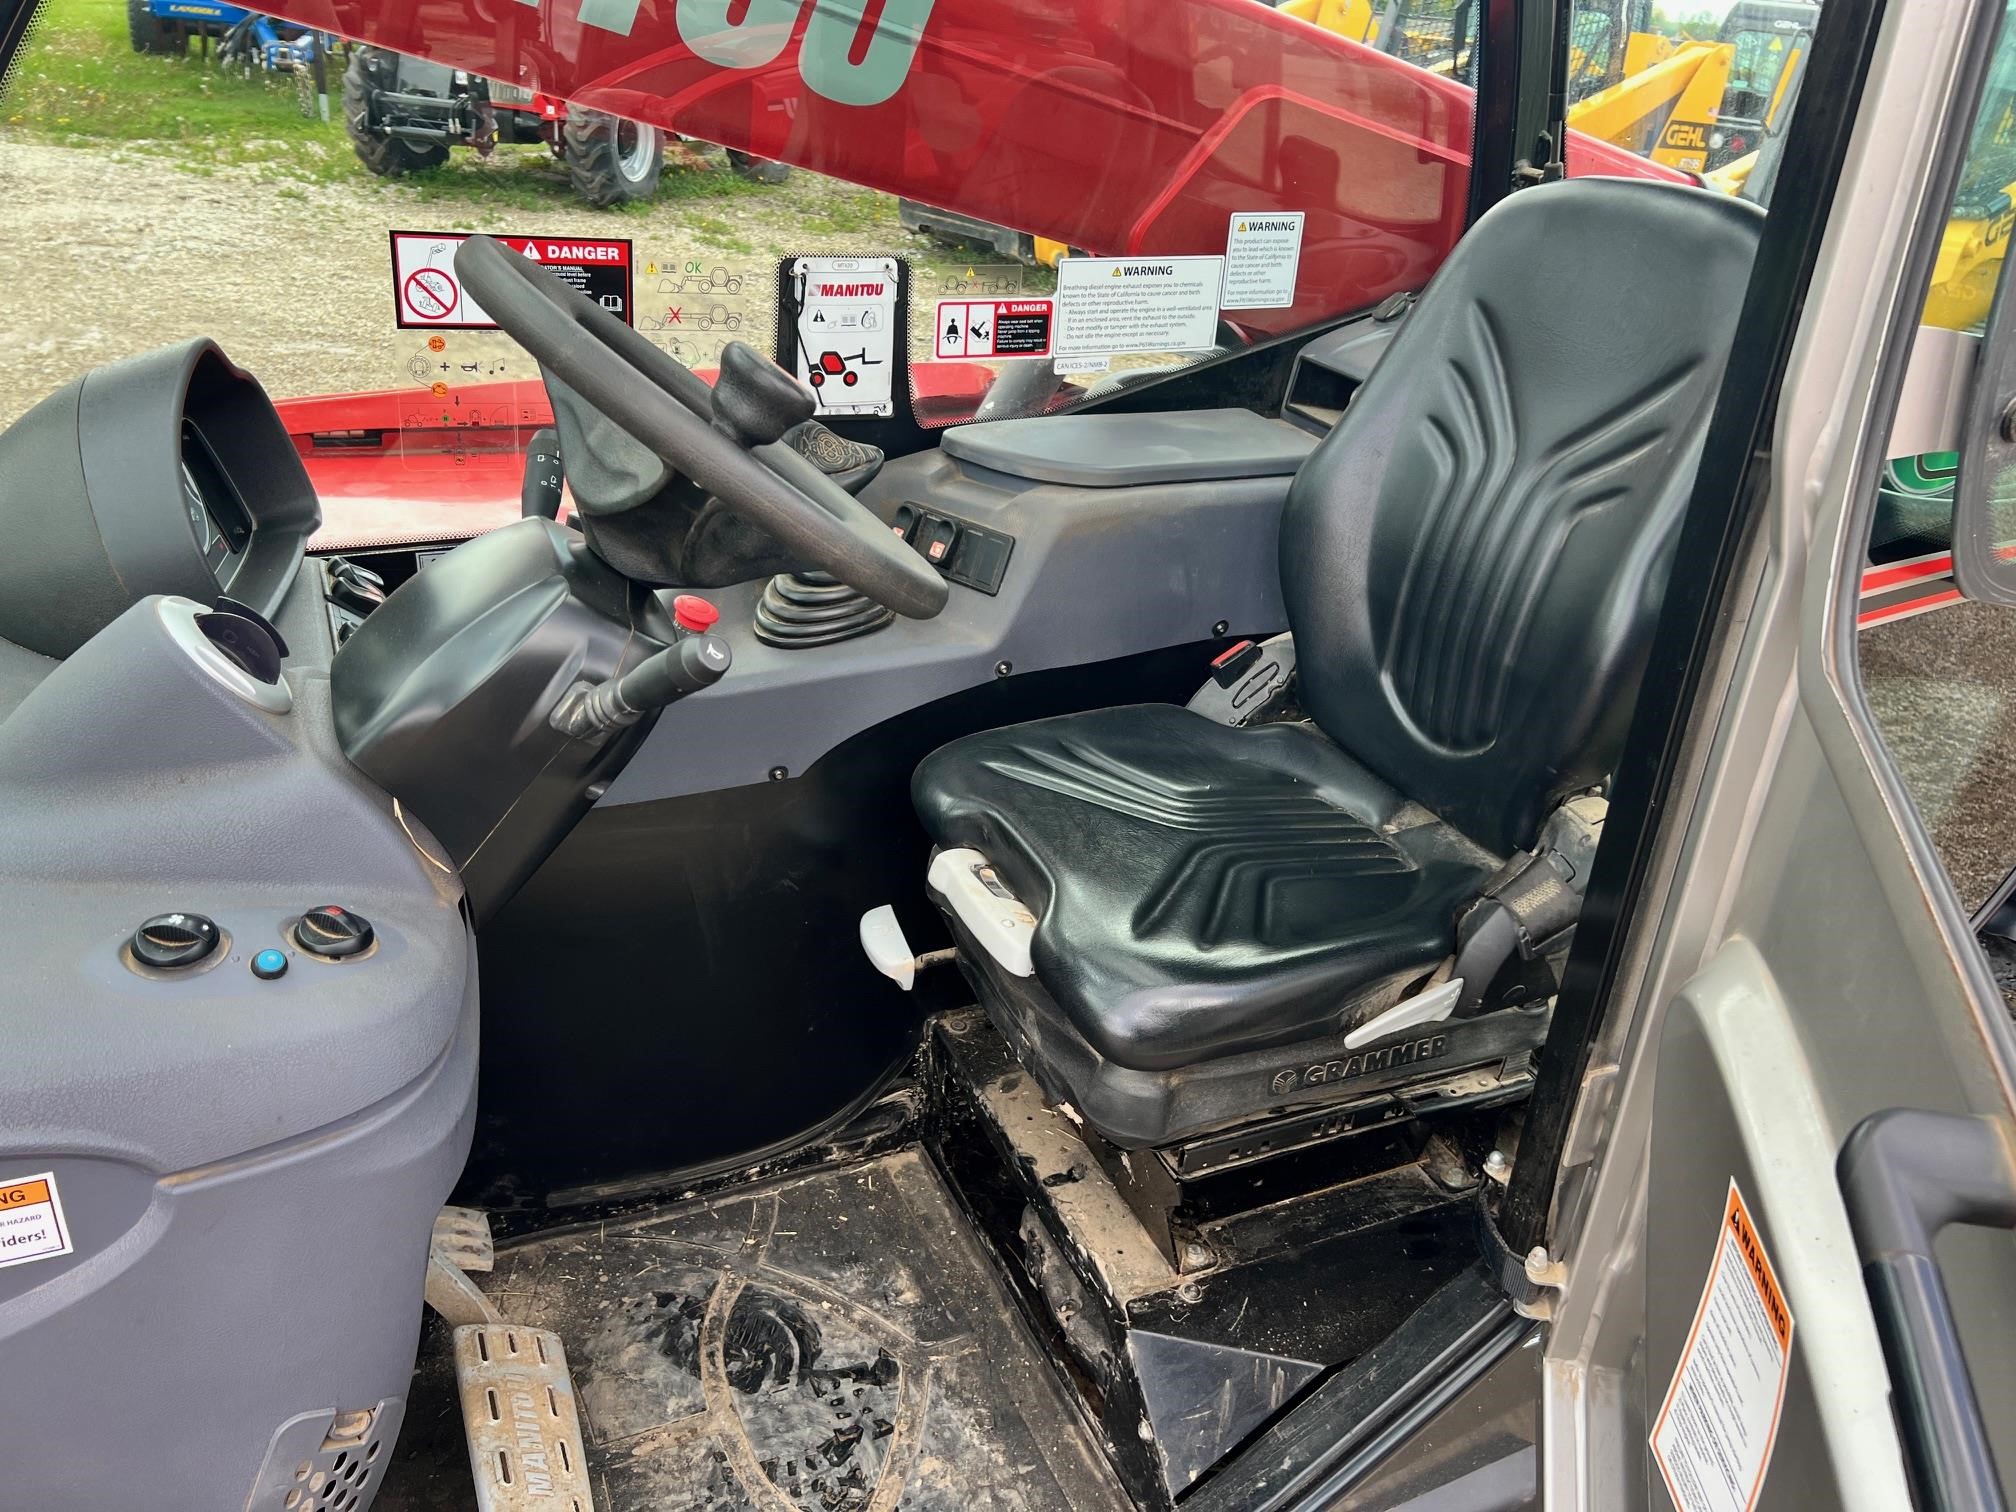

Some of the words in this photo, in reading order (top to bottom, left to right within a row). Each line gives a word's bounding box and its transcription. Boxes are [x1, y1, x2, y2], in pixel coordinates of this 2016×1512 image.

[1666, 124, 1705, 147] GEHL
[1249, 221, 1295, 232] WARNING
[547, 245, 619, 260] DANGER
[685, 261, 702, 273] OK
[1124, 265, 1173, 277] WARNING
[821, 283, 884, 297] MANITOU
[1012, 304, 1047, 312] DANGER
[1303, 1035, 1447, 1083] GRAMMER
[7, 1214, 42, 1226] HAZARD
[1741, 1228, 1785, 1337] WARNING
[504, 1372, 554, 1497] MANITOU
